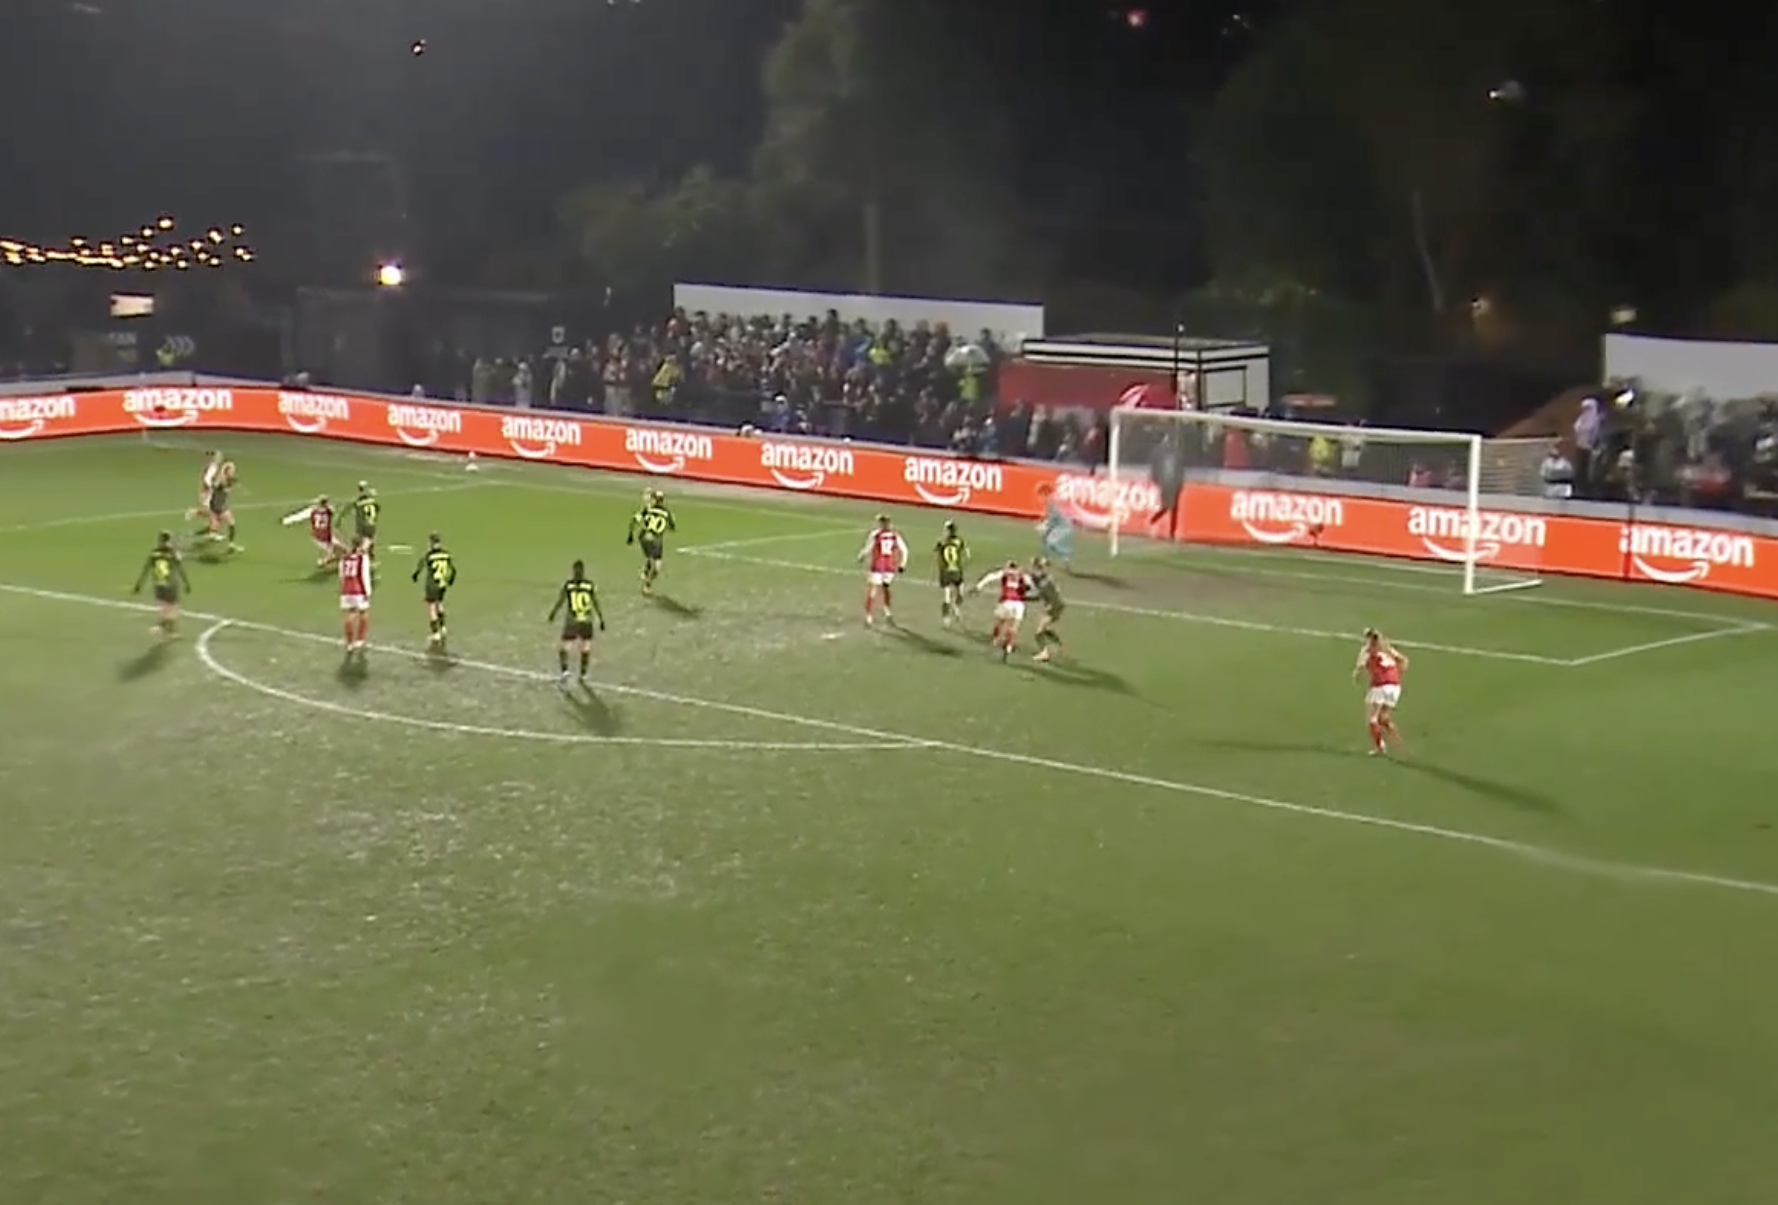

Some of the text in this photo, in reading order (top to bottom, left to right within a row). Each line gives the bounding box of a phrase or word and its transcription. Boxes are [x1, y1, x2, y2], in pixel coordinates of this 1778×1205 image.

[0, 397, 76, 421] mazon
[122, 388, 233, 412] amazon
[278, 391, 349, 420] amazon
[387, 404, 462, 433] amazon
[501, 415, 581, 446] amazon
[625, 428, 712, 459] amazon
[761, 442, 854, 475] amazon
[904, 456, 1002, 491] amazon
[1230, 490, 1343, 526] amazon
[1408, 506, 1547, 546] amazon
[1619, 523, 1754, 567] amazon
[570, 591, 591, 611] 10
